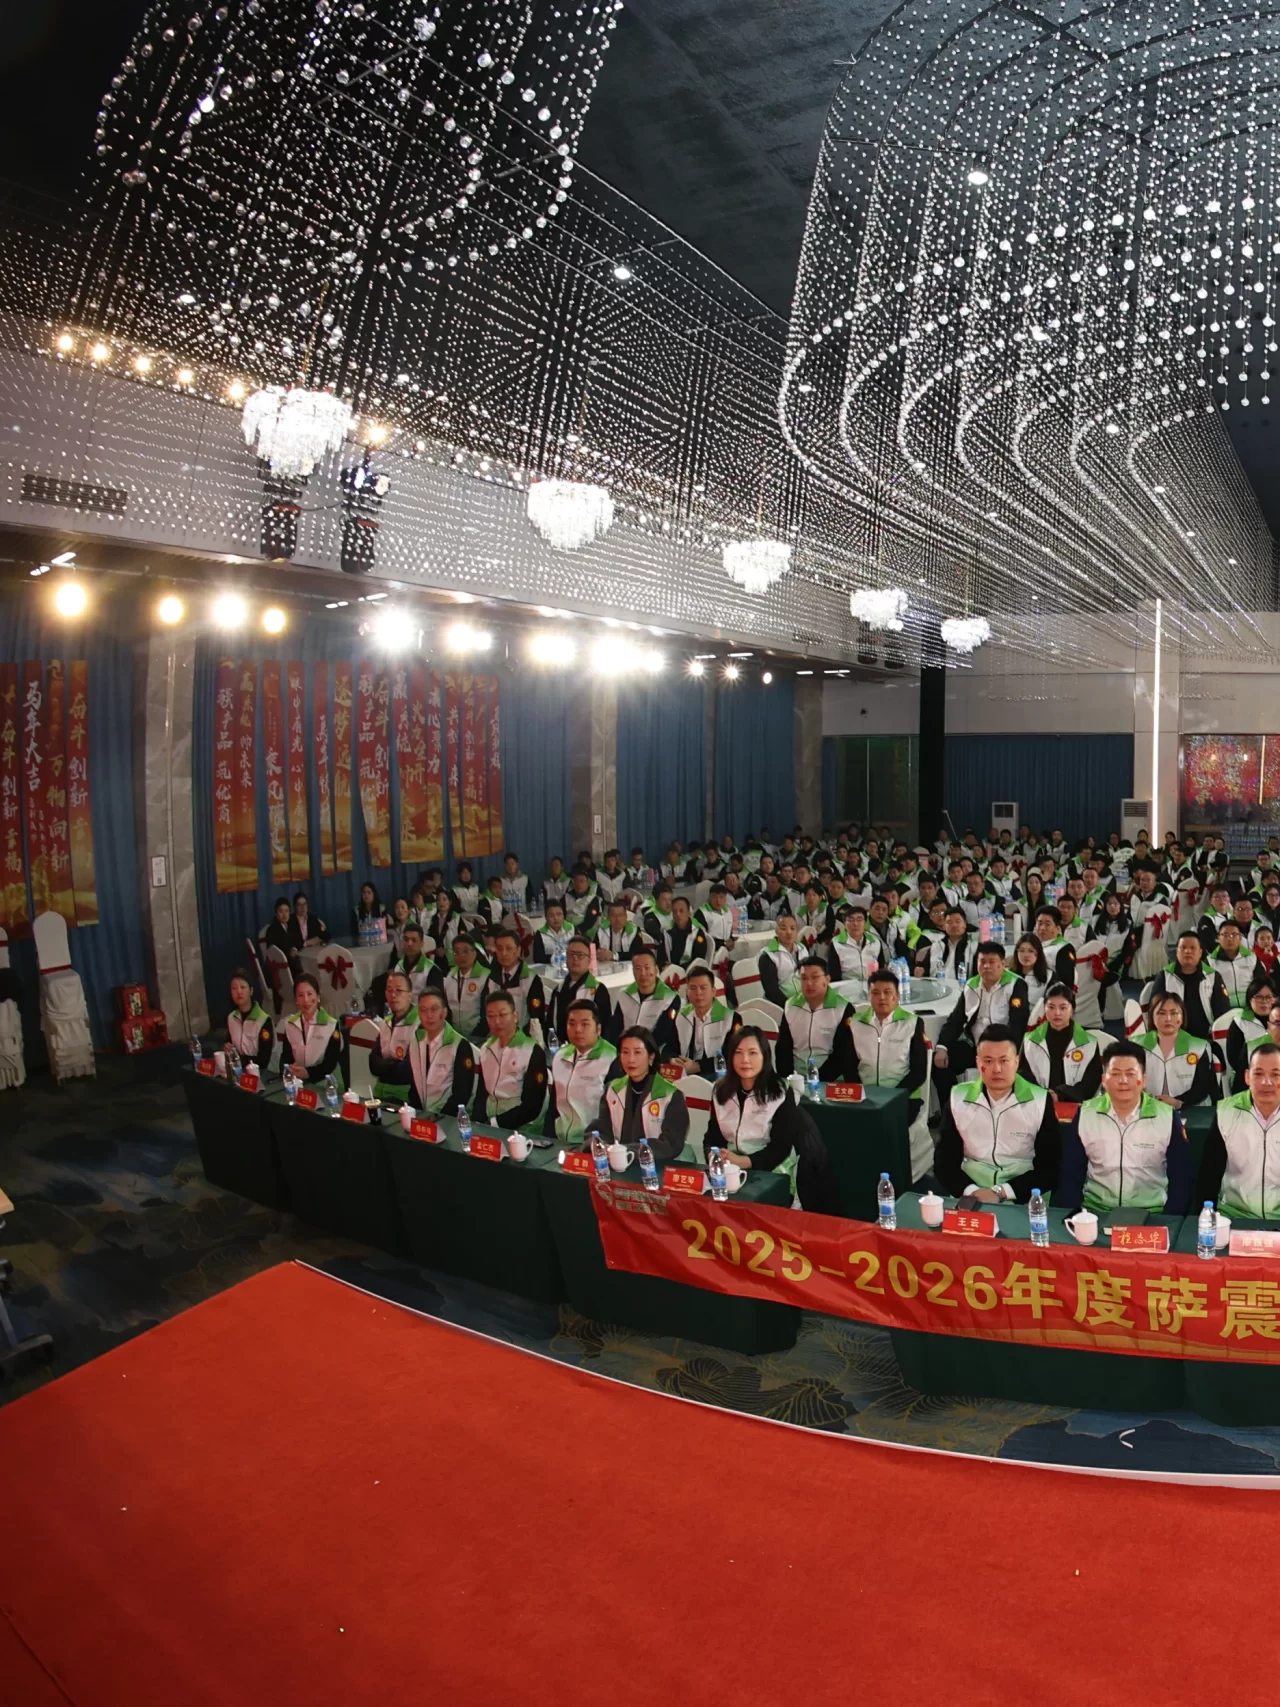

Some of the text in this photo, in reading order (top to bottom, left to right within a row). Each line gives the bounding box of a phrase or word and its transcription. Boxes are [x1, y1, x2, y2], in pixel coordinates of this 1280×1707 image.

[1, 719, 16, 769] 奋斗
[22, 680, 42, 792] 马年大吉
[69, 691, 87, 749] 奋斗
[1, 775, 18, 820] 创新
[69, 756, 88, 808] 创新
[957, 1216, 980, 1229] 王云
